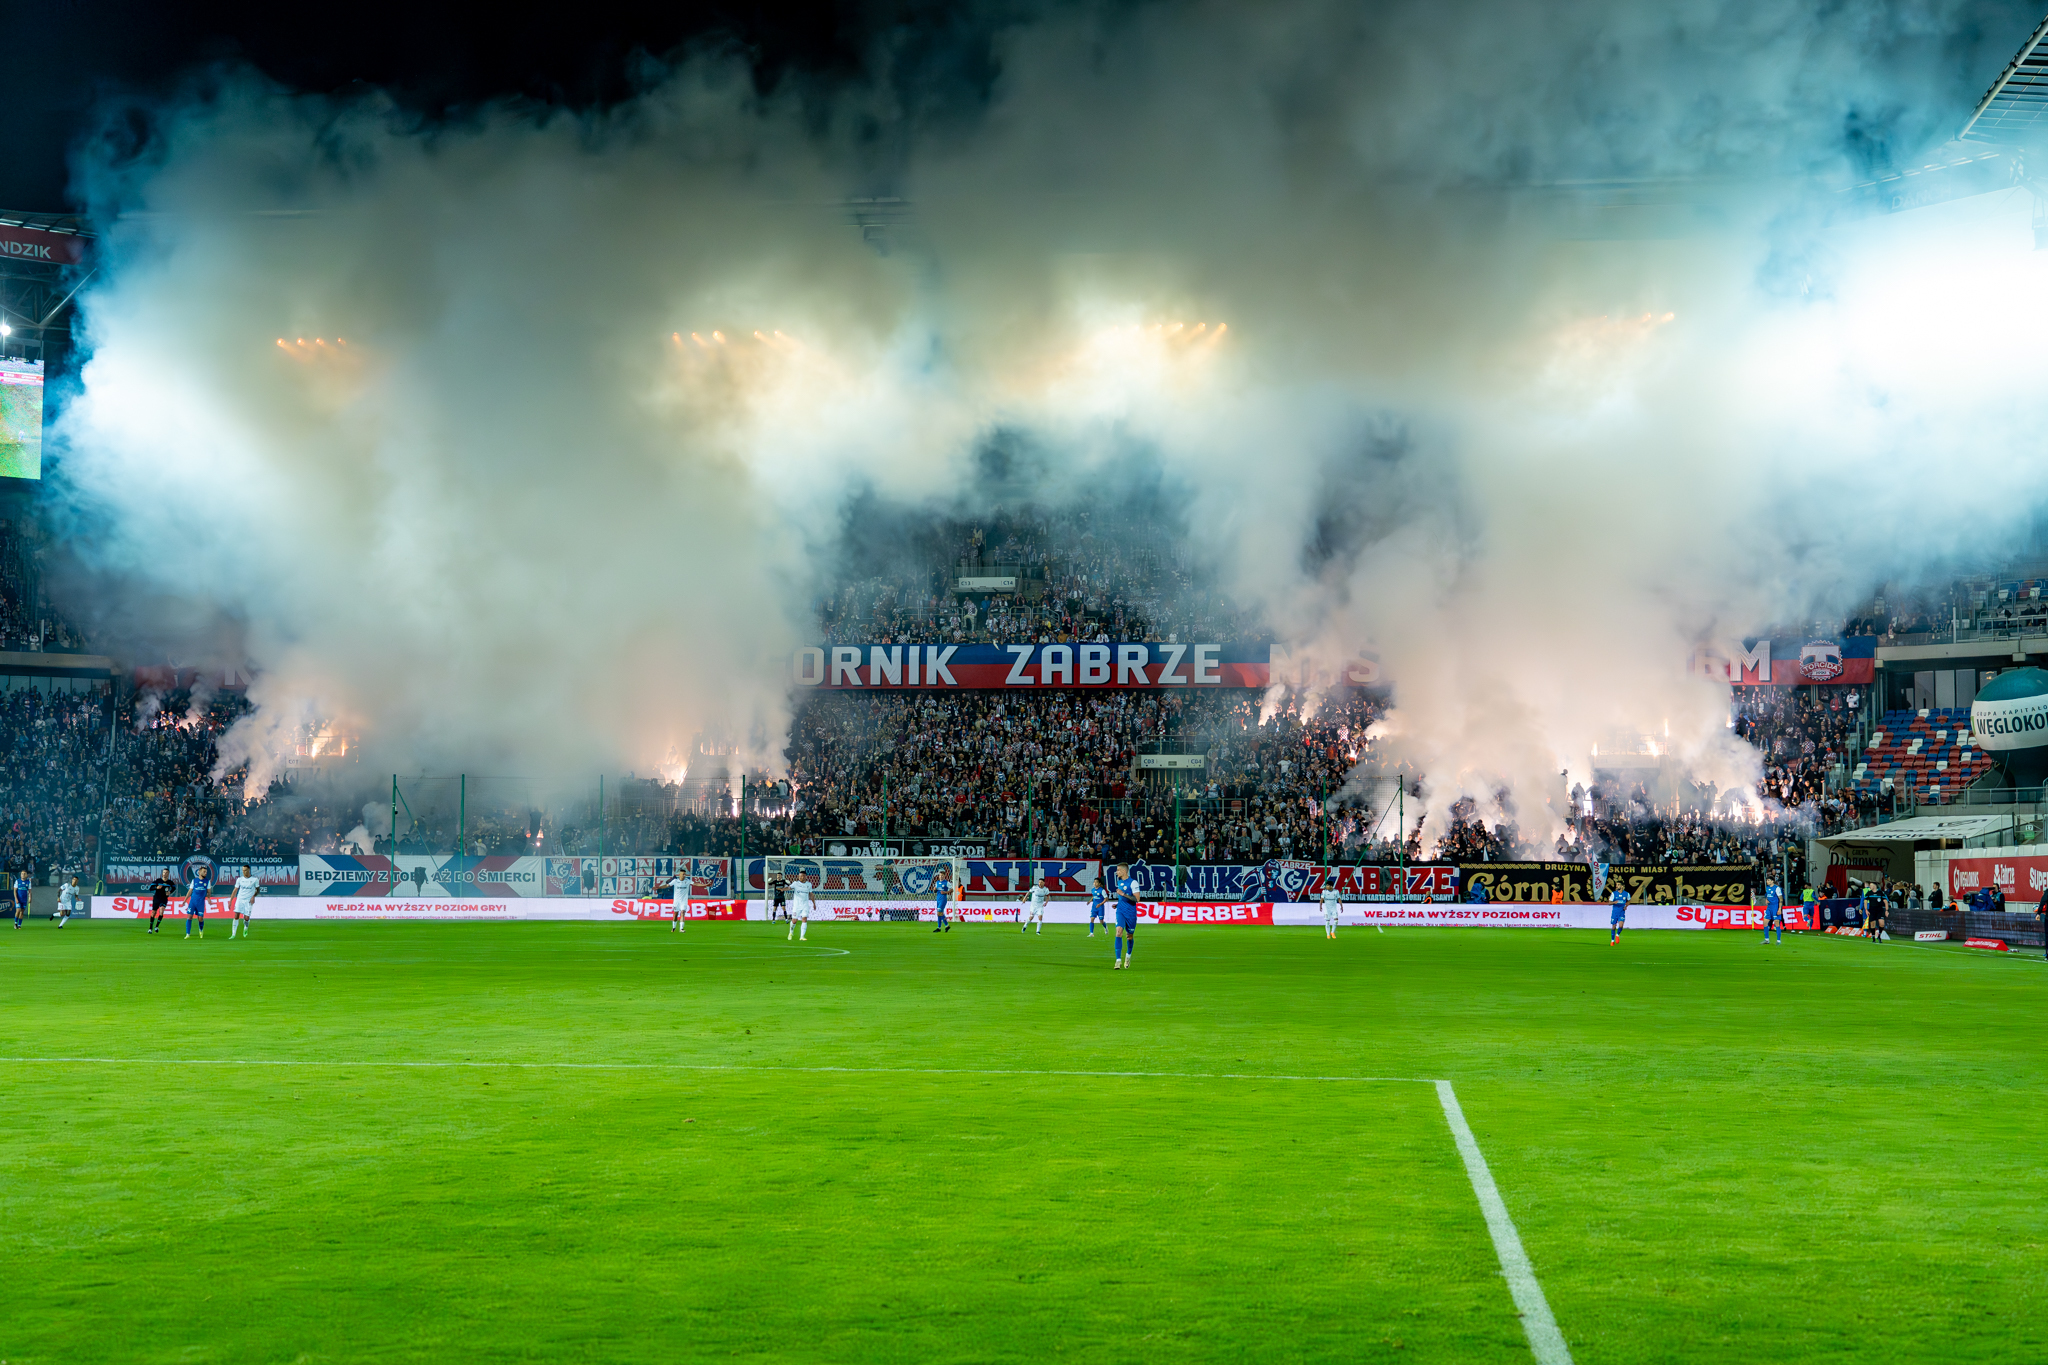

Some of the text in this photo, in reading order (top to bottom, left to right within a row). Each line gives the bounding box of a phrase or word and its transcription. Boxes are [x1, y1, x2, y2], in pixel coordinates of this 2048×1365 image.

[793, 645, 958, 686] ORNIK
[1005, 645, 1221, 685] ZABRZE
[852, 846, 899, 857] DAWID
[930, 845, 985, 856] PASTOR
[1280, 861, 1310, 869] ZABRZE
[1545, 863, 1587, 872] DRUŻYNA
[305, 871, 374, 883] BĘDZIEMY
[378, 871, 388, 881] Z
[433, 869, 451, 882] AŻ
[454, 872, 474, 882] DO
[478, 869, 536, 882] ŚMIERCI
[1309, 866, 1455, 894] ZABRZE
[112, 897, 232, 915] SUPERET
[327, 903, 365, 911] WEJDŹ
[385, 903, 433, 911] WYŻSZY
[1136, 903, 1261, 921] SUPERBET
[1364, 909, 1405, 918] WEJDŹ
[1428, 909, 1480, 919] WYŻSZY
[1483, 911, 1529, 919] POZIOM
[1532, 911, 1560, 919] GRY!
[1676, 906, 1806, 925] SUPERET
